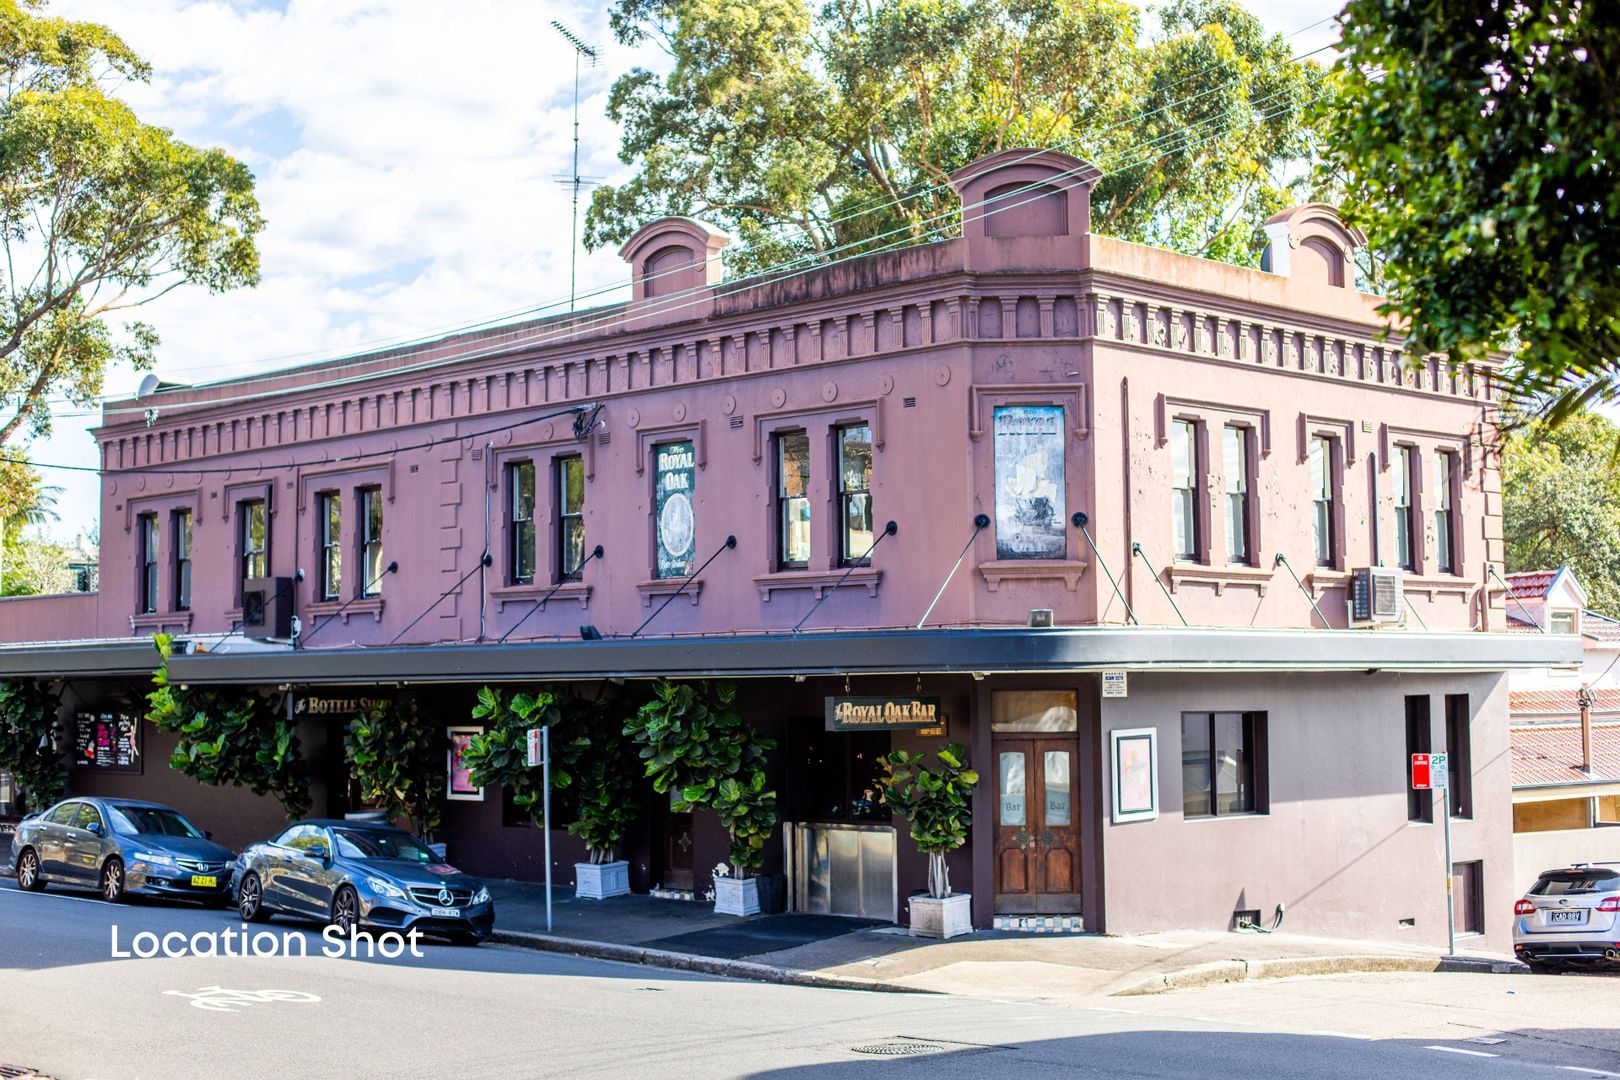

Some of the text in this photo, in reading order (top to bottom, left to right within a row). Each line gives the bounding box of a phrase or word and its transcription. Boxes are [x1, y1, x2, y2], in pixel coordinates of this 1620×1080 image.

[659, 452, 694, 471] ROYAL
[665, 472, 689, 490] OAK
[308, 697, 358, 714] BOTTLE
[842, 702, 884, 723] ROYAL
[884, 702, 911, 723] OAK
[911, 701, 937, 722] BAR
[1431, 755, 1446, 765] 2P
[1006, 802, 1021, 811] Bar
[1050, 800, 1065, 810] Bar
